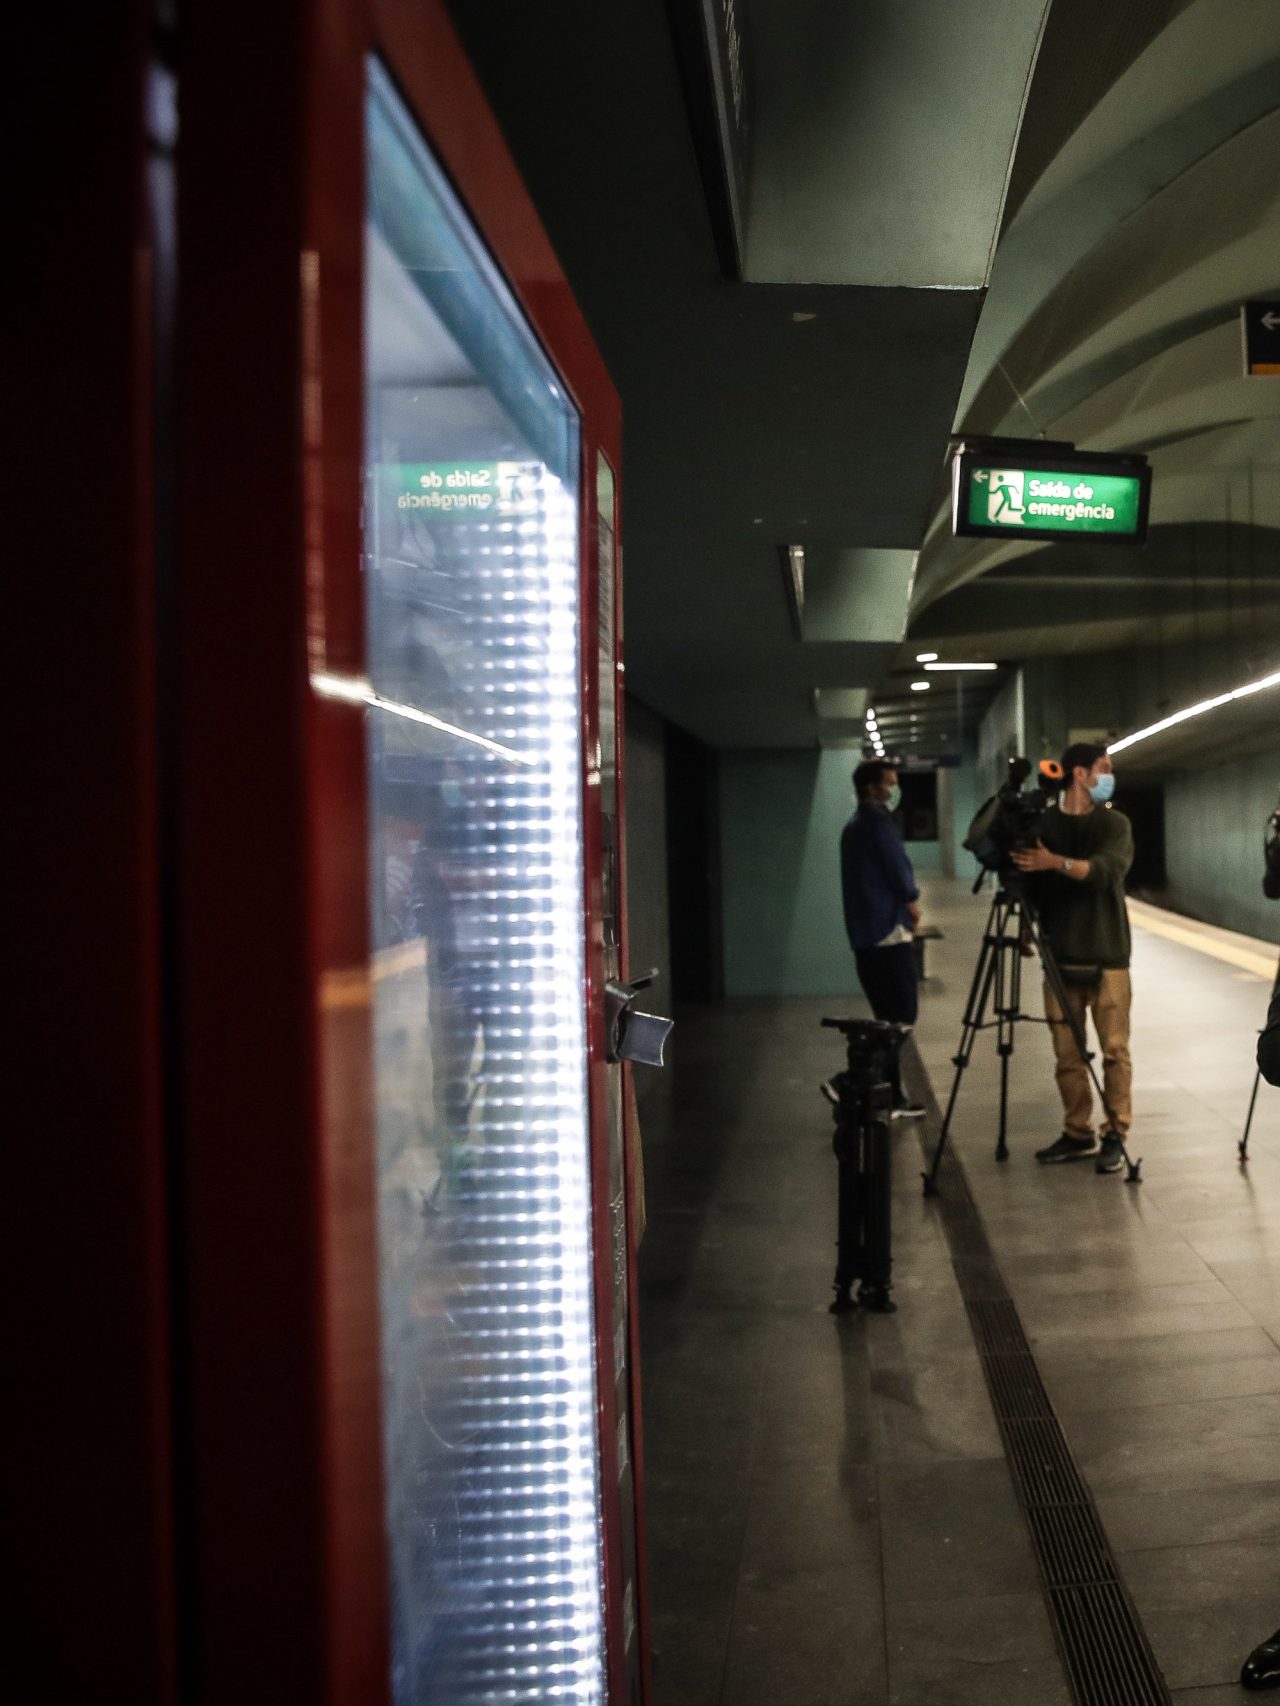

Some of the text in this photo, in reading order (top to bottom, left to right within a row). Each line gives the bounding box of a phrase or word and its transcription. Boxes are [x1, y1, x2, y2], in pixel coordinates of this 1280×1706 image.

[1028, 479, 1094, 500] Saída de
[1028, 501, 1115, 521] emergência
